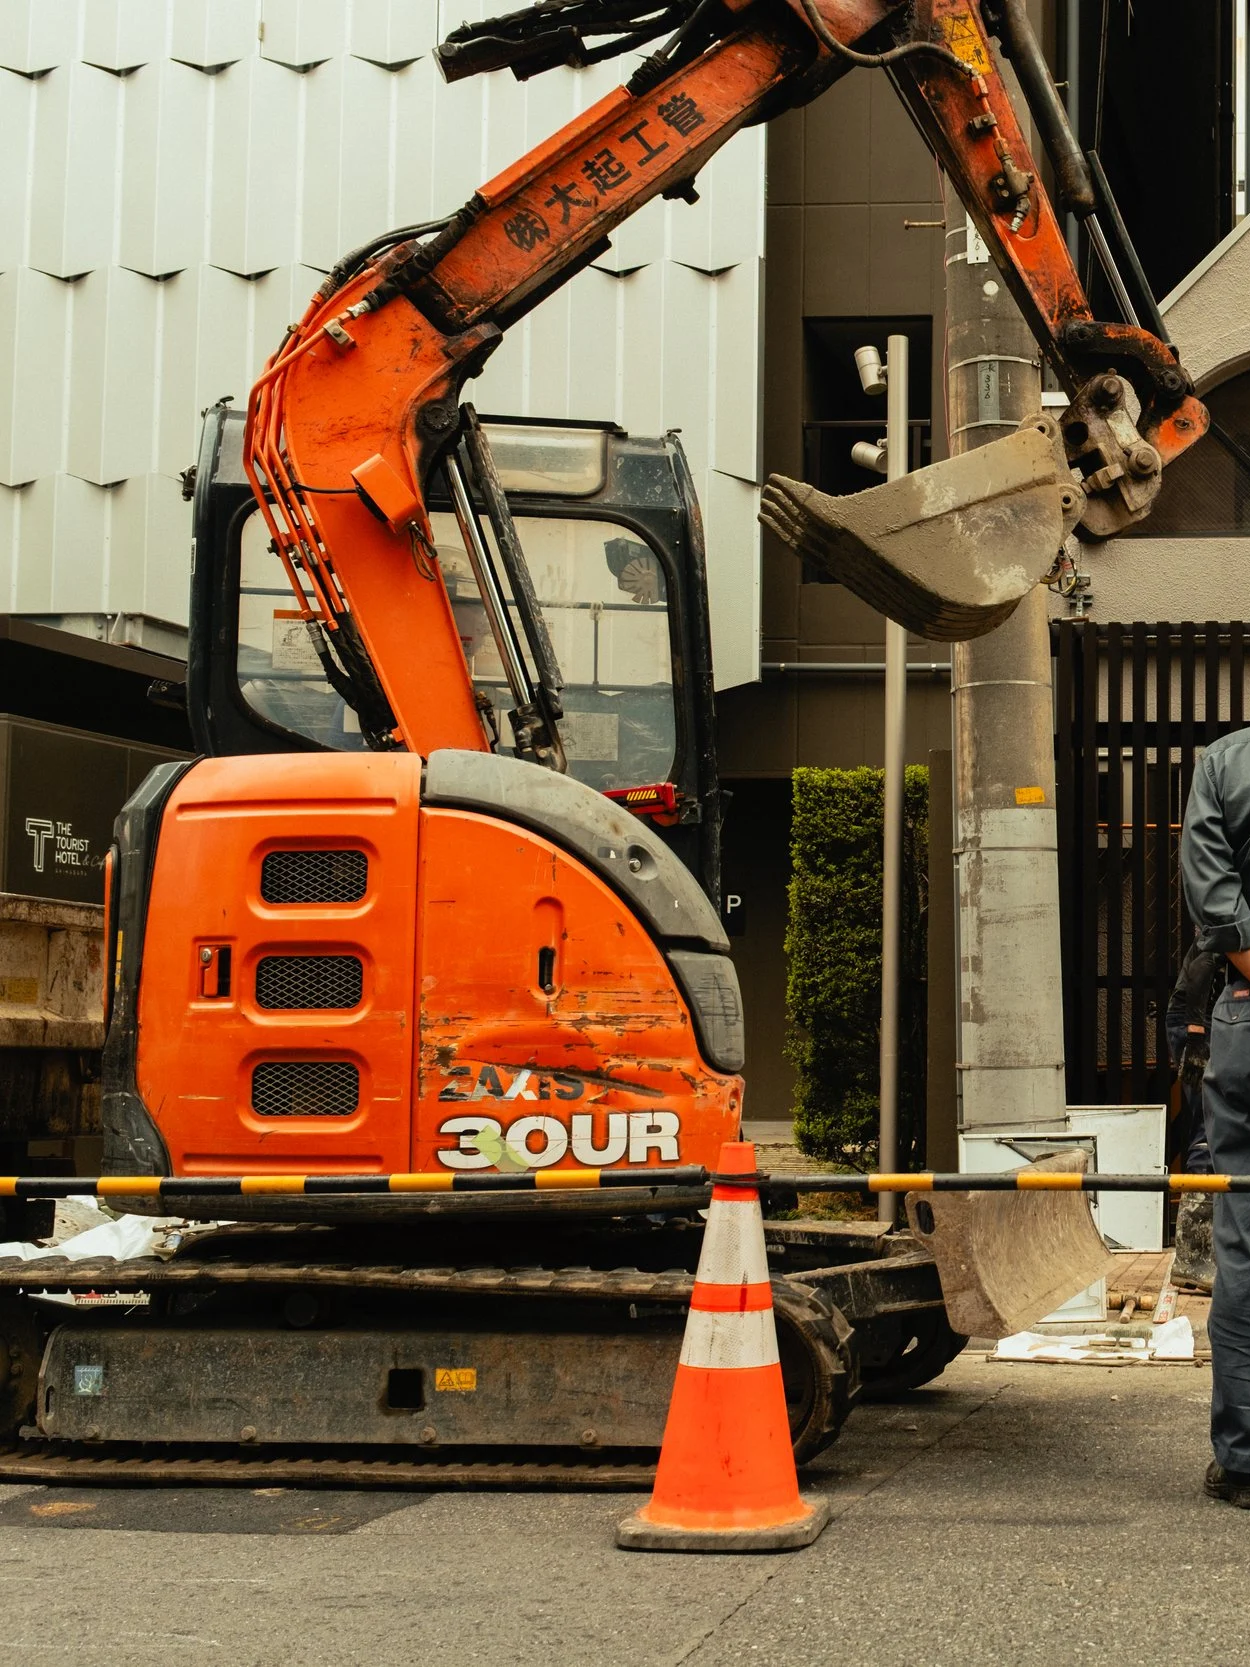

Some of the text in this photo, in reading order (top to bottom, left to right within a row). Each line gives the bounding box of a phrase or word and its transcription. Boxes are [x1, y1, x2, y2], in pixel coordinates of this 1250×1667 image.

[56, 821, 72, 836] THE
[55, 836, 90, 852] TOURIST
[54, 851, 81, 866] HOTEL
[726, 894, 742, 914] P
[436, 1110, 680, 1170] 30UR
